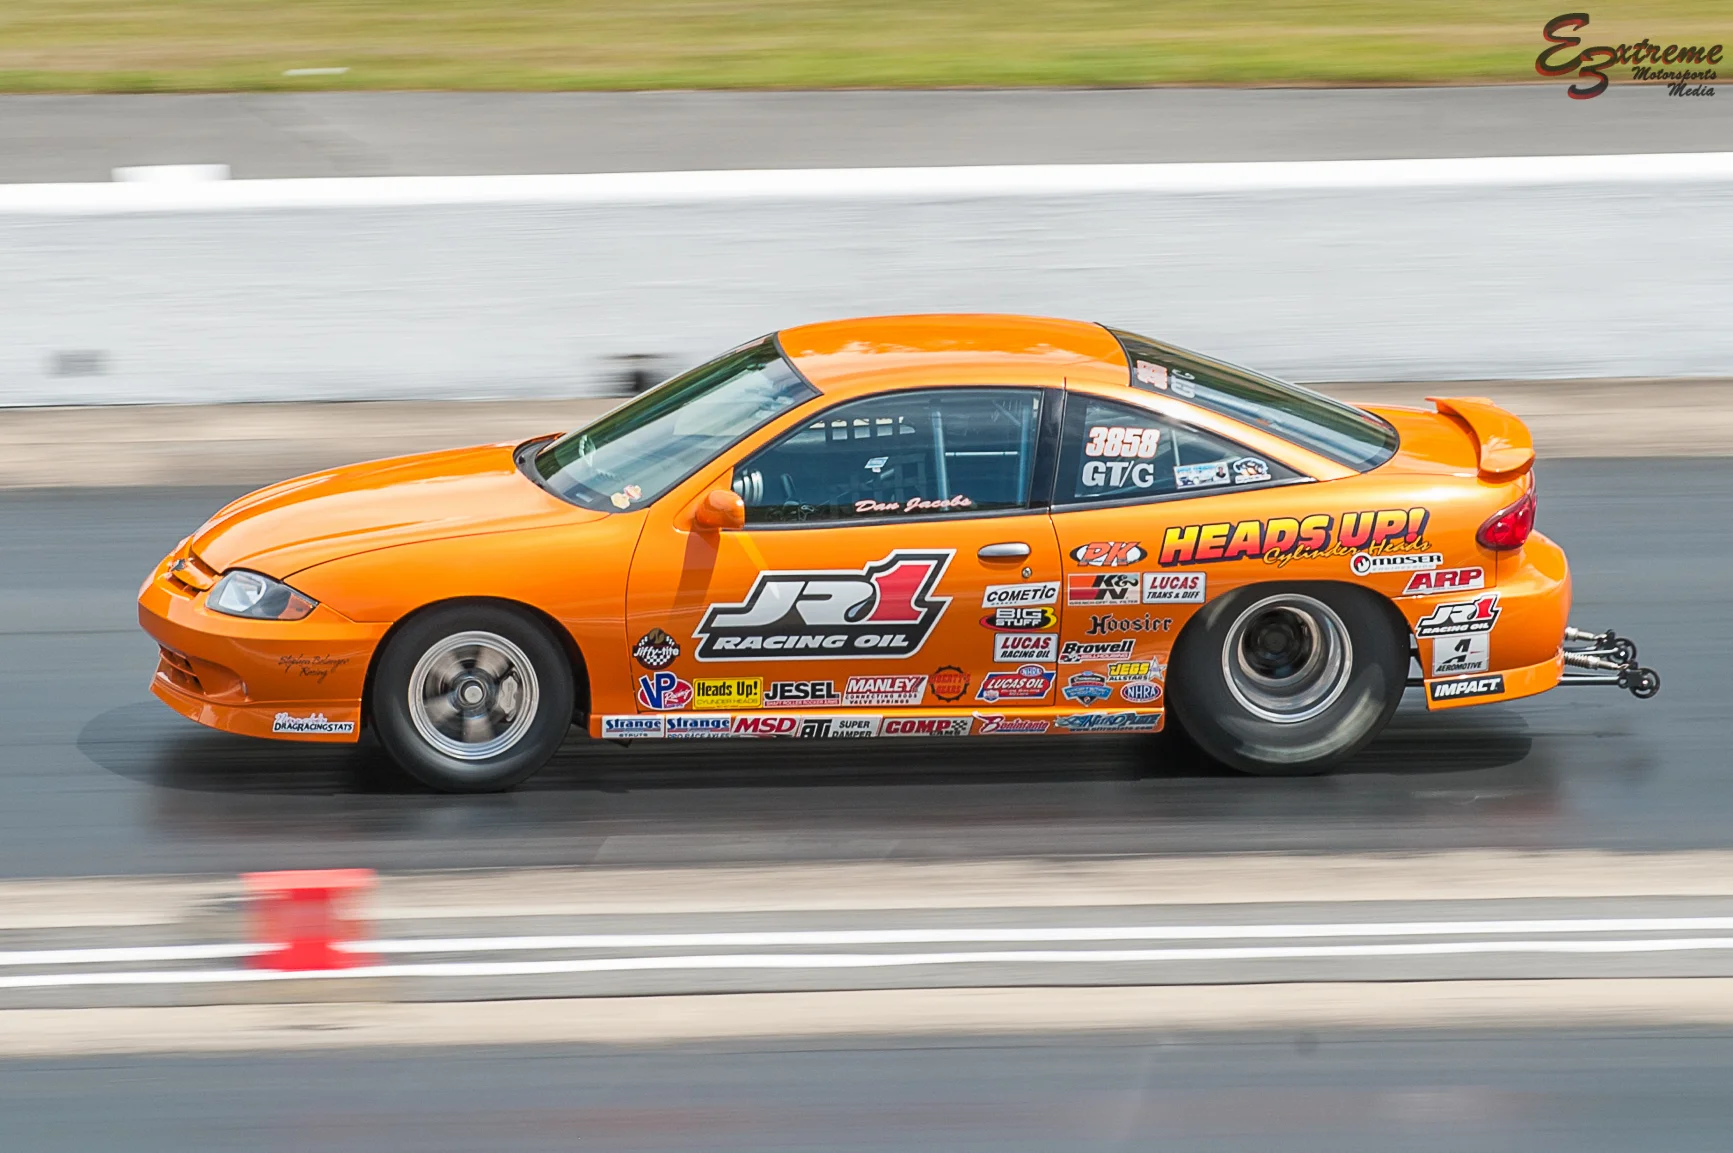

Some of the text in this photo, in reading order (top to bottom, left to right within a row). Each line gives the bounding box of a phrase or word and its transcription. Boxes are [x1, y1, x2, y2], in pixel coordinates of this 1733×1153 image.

[1085, 426, 1160, 458] 3858
[1082, 460, 1154, 488] GT/G
[855, 494, 972, 513] Dan Jacobs
[1158, 506, 1430, 567] HEADS UP!
[1263, 535, 1431, 567] Cylinder Heads
[1150, 576, 1200, 590] LUCAS
[1408, 569, 1482, 590] ARP
[711, 563, 935, 627] JR1
[987, 585, 1056, 603] COMETIC
[1147, 591, 1172, 599] TRANS
[1181, 591, 1200, 599] DIFF
[996, 607, 1042, 618] BIG
[1421, 598, 1493, 626] JR1
[995, 618, 1042, 626] STUFF
[1085, 612, 1173, 636] Hoosier
[1422, 622, 1490, 634] RACING OIL
[712, 633, 909, 650] RACING OIL
[1001, 636, 1052, 649] LUCAS
[1062, 640, 1134, 654] Browell
[1000, 650, 1050, 658] RACING OIL
[1110, 662, 1149, 676] JEGS
[1436, 661, 1483, 672] AEROMOTIVE
[697, 681, 758, 698] Heads Up!
[848, 678, 916, 692] MANLEY
[987, 678, 1045, 689] LUCAS OIL
[1434, 678, 1501, 697] IMPACT
[640, 673, 676, 709] VP
[764, 682, 839, 700] JESEL
[1127, 685, 1156, 698] NHRA
[606, 718, 661, 729] Strange
[667, 717, 730, 729] Strange
[734, 717, 797, 733] MSD
[839, 720, 870, 729] SUPER
[885, 720, 952, 734] COMP
